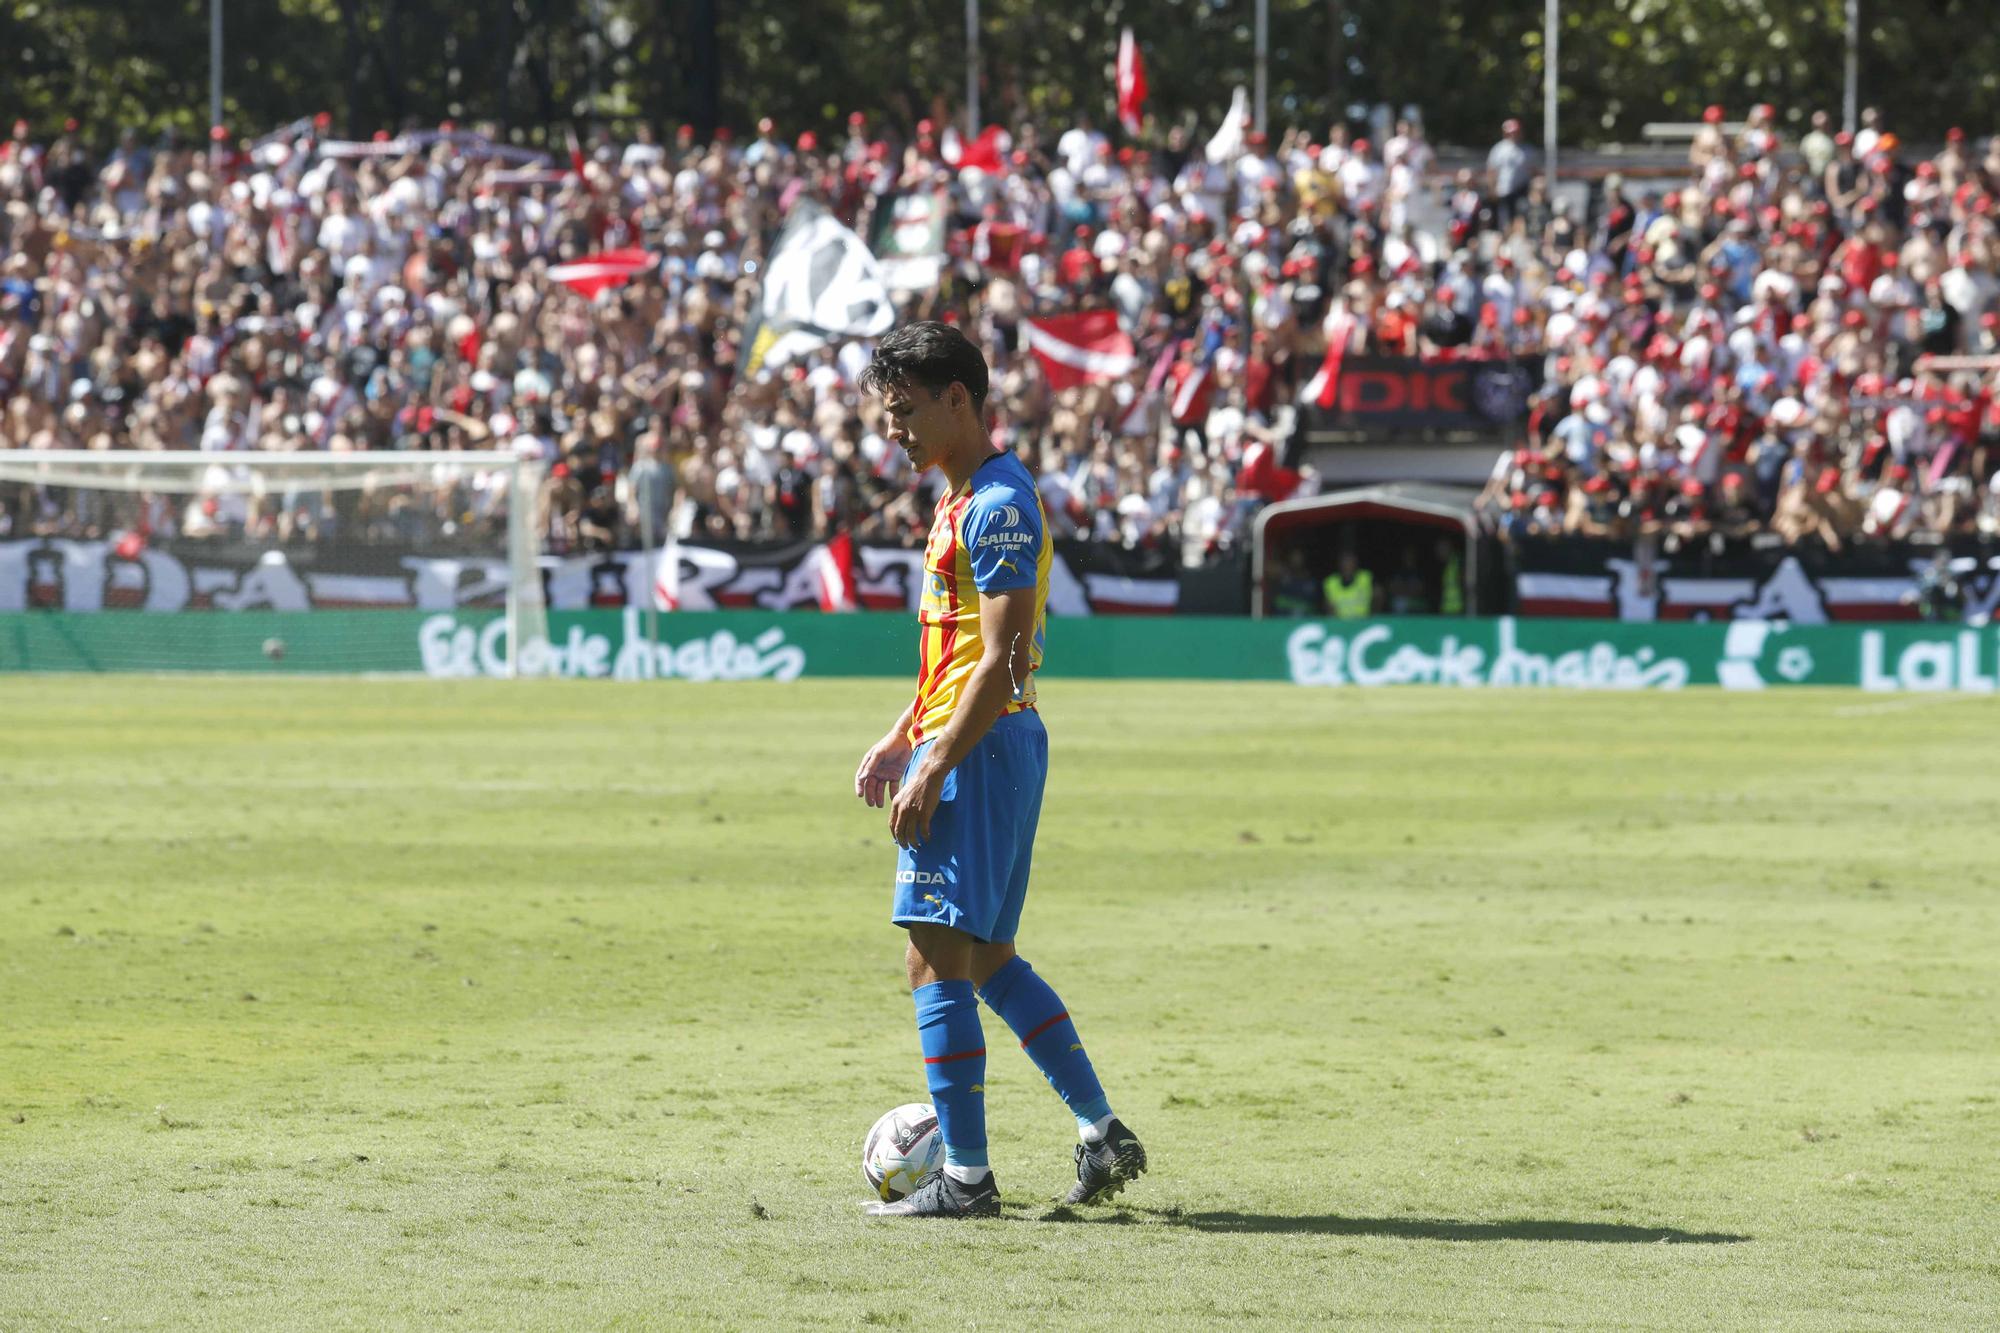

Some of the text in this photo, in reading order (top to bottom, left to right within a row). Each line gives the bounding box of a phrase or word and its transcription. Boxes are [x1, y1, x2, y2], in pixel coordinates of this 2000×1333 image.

[978, 532, 1034, 547] SAILUN
[992, 543, 1021, 552] TYRE
[417, 613, 479, 678] El
[479, 617, 611, 679] Corte
[1286, 622, 1347, 686] El
[1347, 624, 1487, 687] Corte
[1861, 628, 2000, 692] LaL
